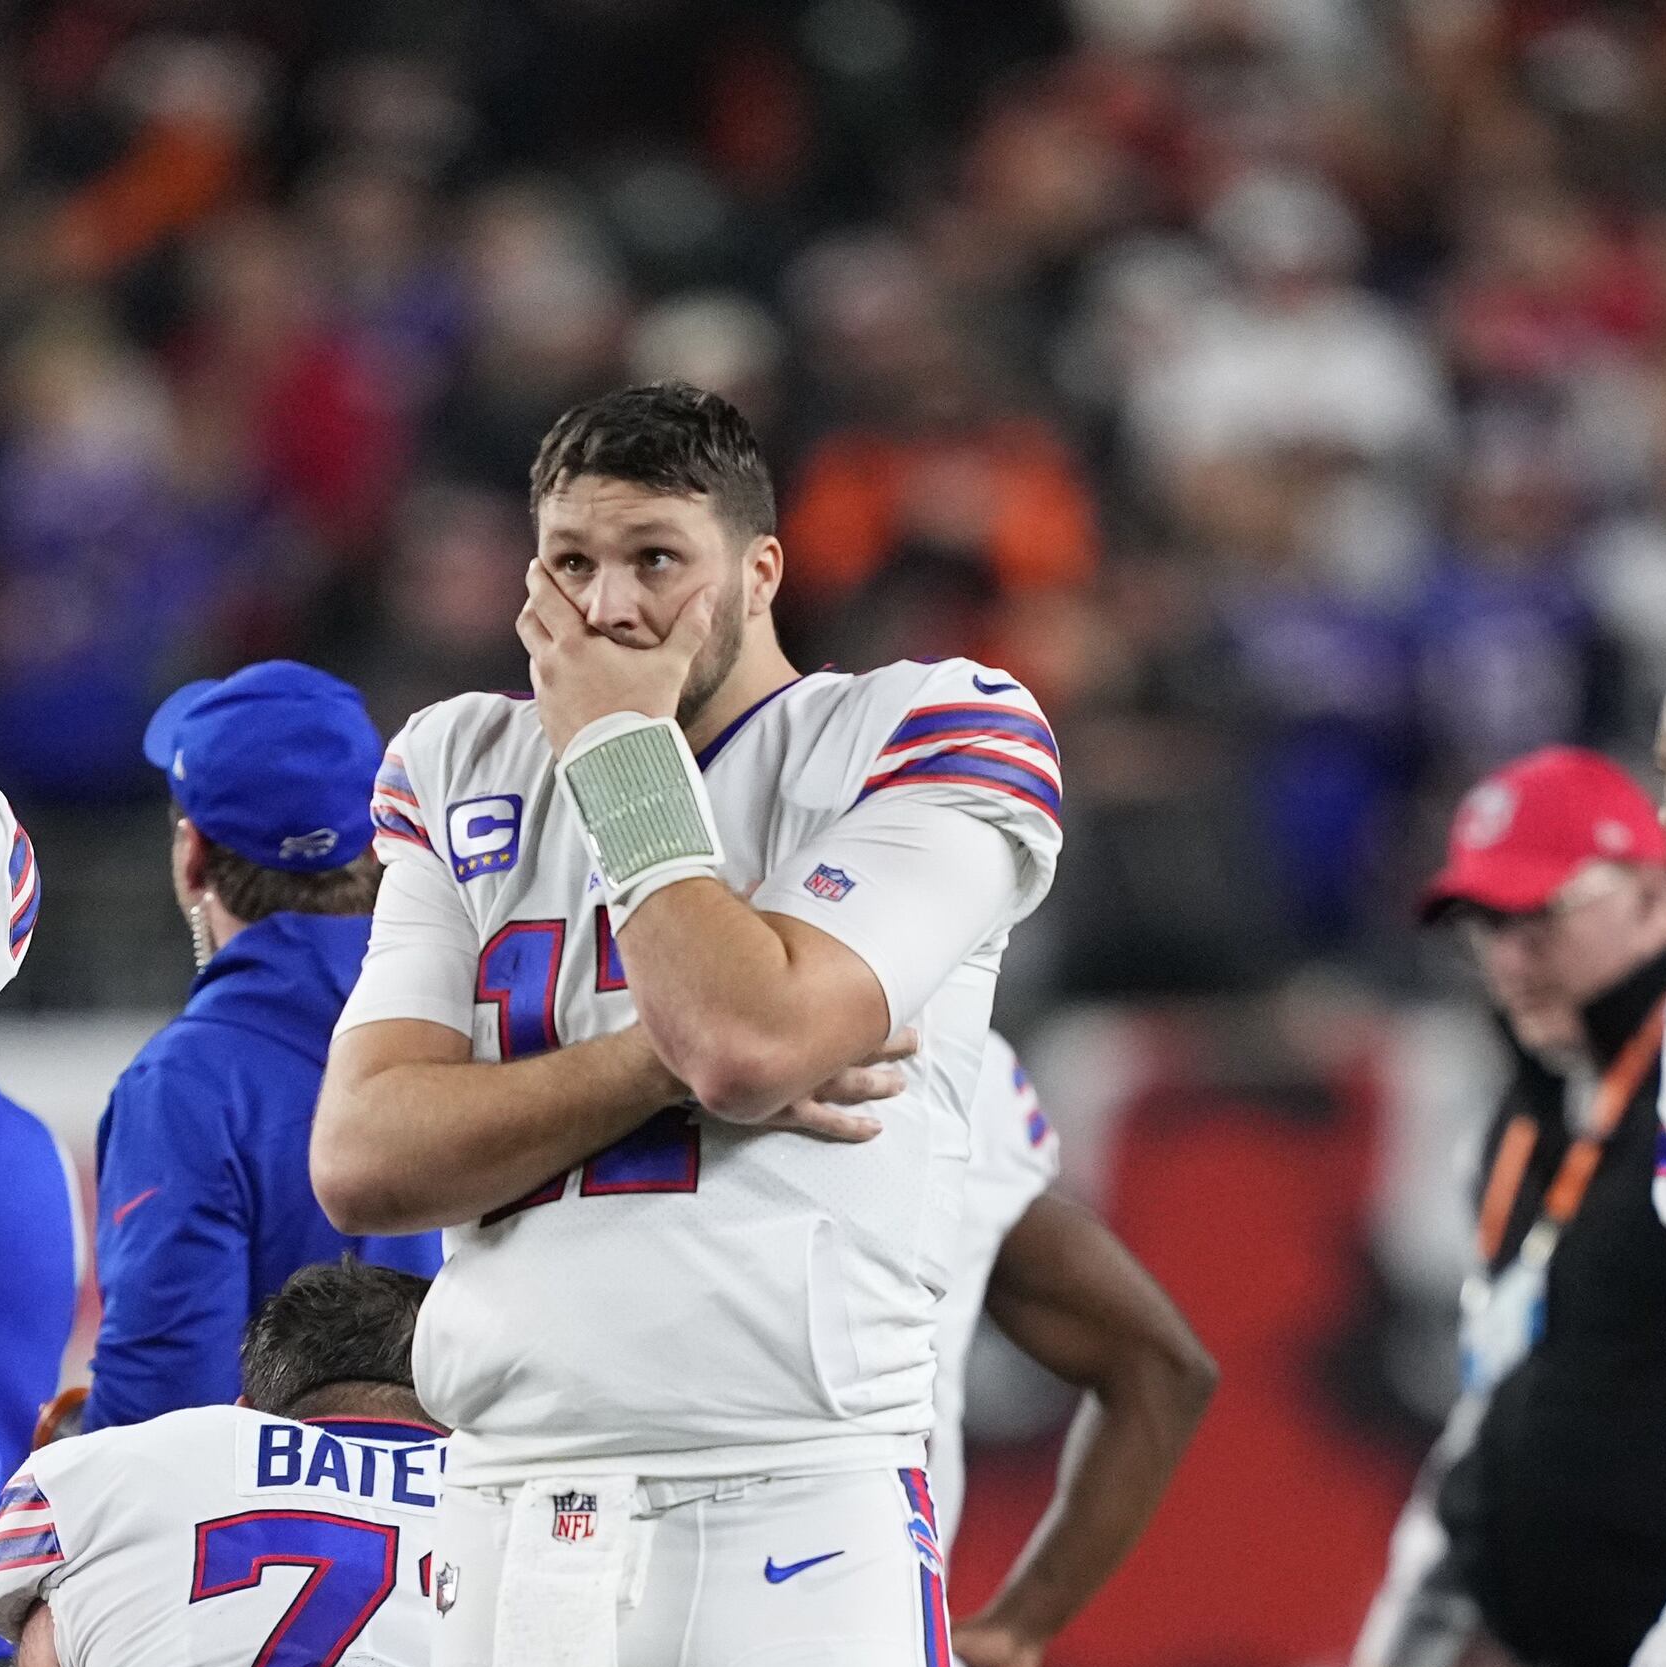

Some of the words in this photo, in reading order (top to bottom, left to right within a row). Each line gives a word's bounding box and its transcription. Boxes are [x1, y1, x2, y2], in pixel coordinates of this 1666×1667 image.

[449, 798, 515, 859] C
[806, 875, 841, 901] NFL
[257, 1425, 447, 1508] BATE
[558, 1514, 595, 1541] NFL
